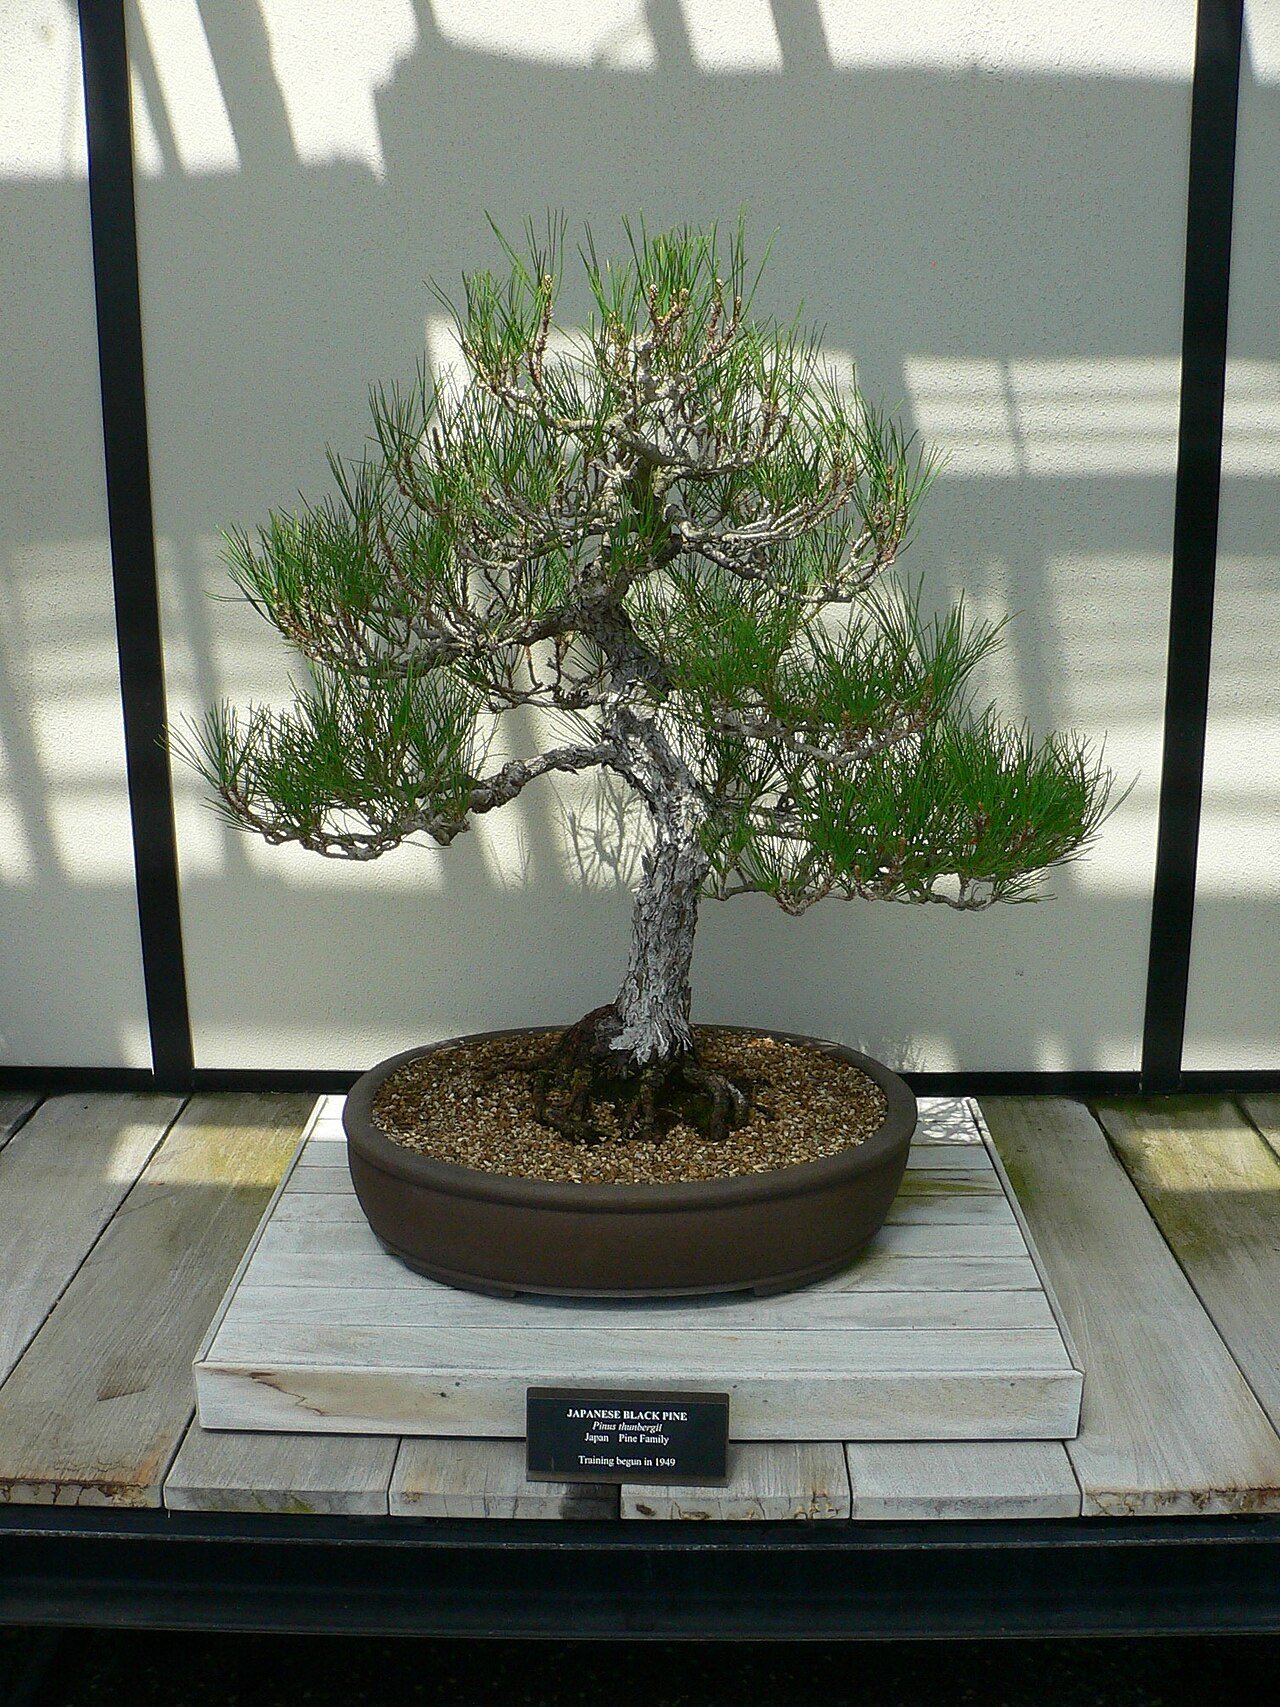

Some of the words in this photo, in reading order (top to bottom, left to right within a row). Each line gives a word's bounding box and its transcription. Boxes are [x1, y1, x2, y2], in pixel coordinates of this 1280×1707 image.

[566, 1409, 620, 1419] JAPANESE
[623, 1411, 660, 1420] BLACK
[662, 1412, 688, 1421] PINE
[592, 1421, 616, 1431] Pinus
[584, 1433, 609, 1443] Japan
[618, 1434, 638, 1443] Pine
[639, 1434, 670, 1446] Family
[578, 1455, 615, 1467] Training
[616, 1456, 642, 1467] begun
[643, 1457, 653, 1466] in
[655, 1458, 676, 1467] 1949
